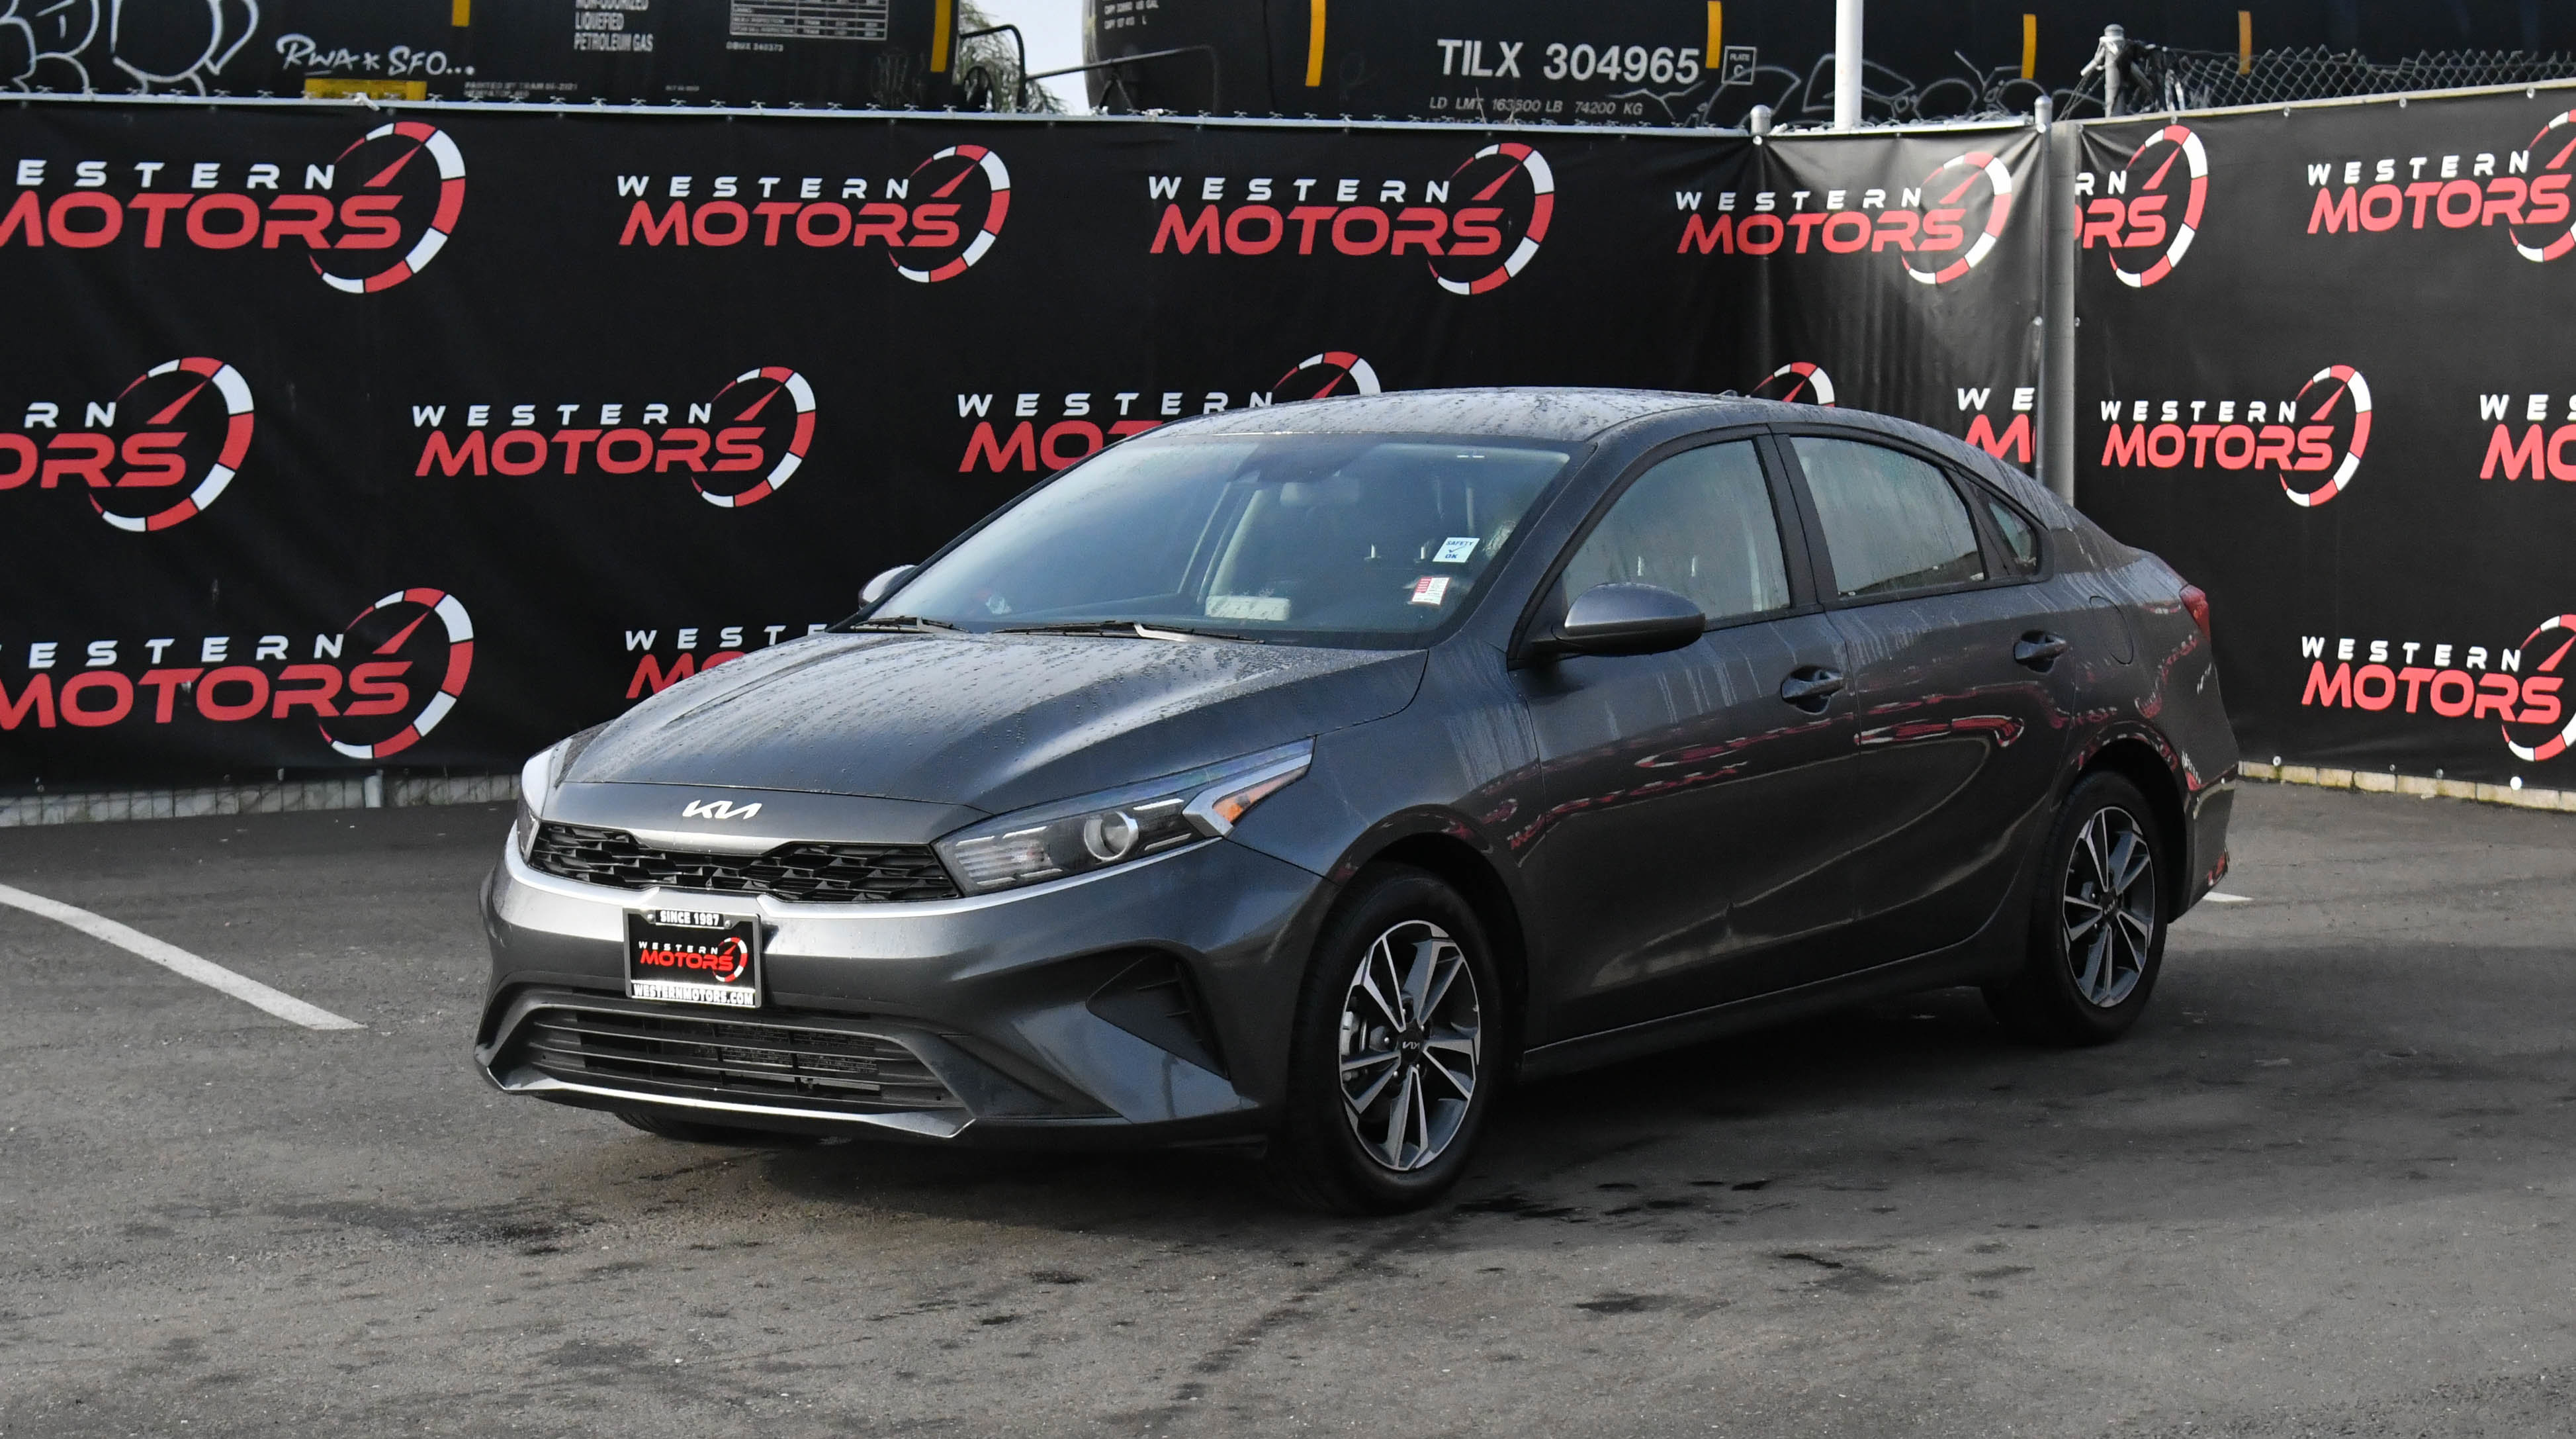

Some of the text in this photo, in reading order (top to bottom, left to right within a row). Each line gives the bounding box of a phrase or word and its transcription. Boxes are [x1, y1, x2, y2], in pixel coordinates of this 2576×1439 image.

[575, 12, 624, 30] LIQUEFIED
[574, 32, 654, 52] PETROLEUM GAS
[1437, 38, 1700, 84] TILX 304965
[1730, 53, 1751, 62] PLATE
[1429, 97, 1447, 110] LD
[1456, 97, 1484, 110] LMT
[1545, 100, 1563, 113] LB
[1575, 101, 1615, 115] 74200
[1623, 103, 1643, 116] KG
[17, 160, 335, 190] ESTERN
[2307, 150, 2530, 187] WESTERN
[617, 175, 909, 199] WESTERN
[1149, 176, 1449, 203] WESTERN
[1675, 188, 1922, 211] WESTERN
[2307, 173, 2573, 234] MOTORS
[619, 200, 961, 248] MOTORS
[1150, 203, 1504, 256] MOTORS
[1677, 209, 1967, 255] MOTORS
[412, 403, 711, 427] WESTERN
[957, 392, 1272, 418] WESTERN
[2100, 400, 2297, 423] WESTERN
[416, 427, 766, 477] MOTORS
[2101, 423, 2335, 471] MOTORS
[0, 633, 344, 669] ESTERN
[2301, 635, 2521, 672] WESTERN
[2301, 660, 2565, 725] MOTORS
[660, 910, 720, 926] SINCE 1987
[639, 941, 719, 955] WESTERN
[640, 949, 734, 972] MOTORS
[633, 984, 754, 1005] WESTERNMOTORS.COM
